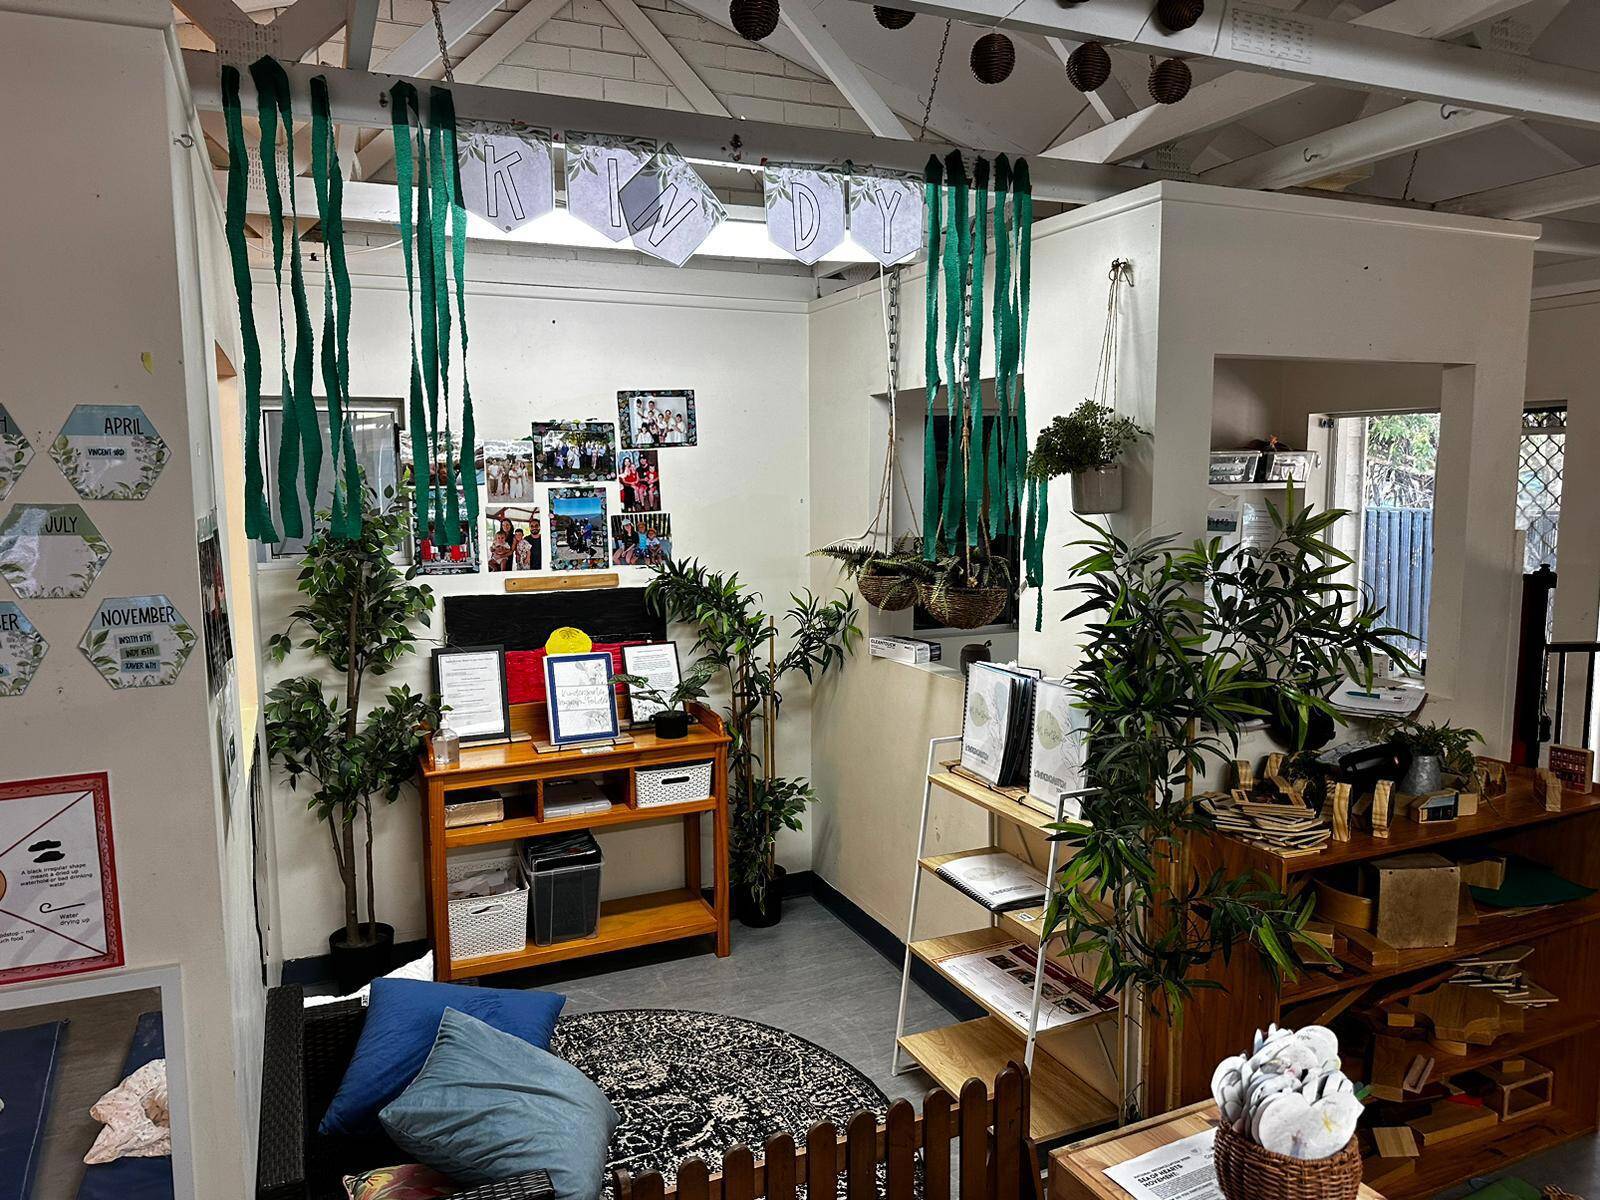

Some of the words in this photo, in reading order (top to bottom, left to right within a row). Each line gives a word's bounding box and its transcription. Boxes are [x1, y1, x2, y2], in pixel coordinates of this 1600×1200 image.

[104, 417, 144, 435] APRIL
[45, 516, 77, 533] JULY
[0, 613, 19, 630] ER
[100, 605, 176, 627] NOVEMBER
[43, 865, 68, 873] irregular
[59, 912, 79, 920] Water
[1137, 1175, 1150, 1183] SEA
[1150, 1171, 1158, 1179] OF
[1159, 1164, 1183, 1175] HEARTS
[1142, 1172, 1179, 1187] MOVEMENT:
